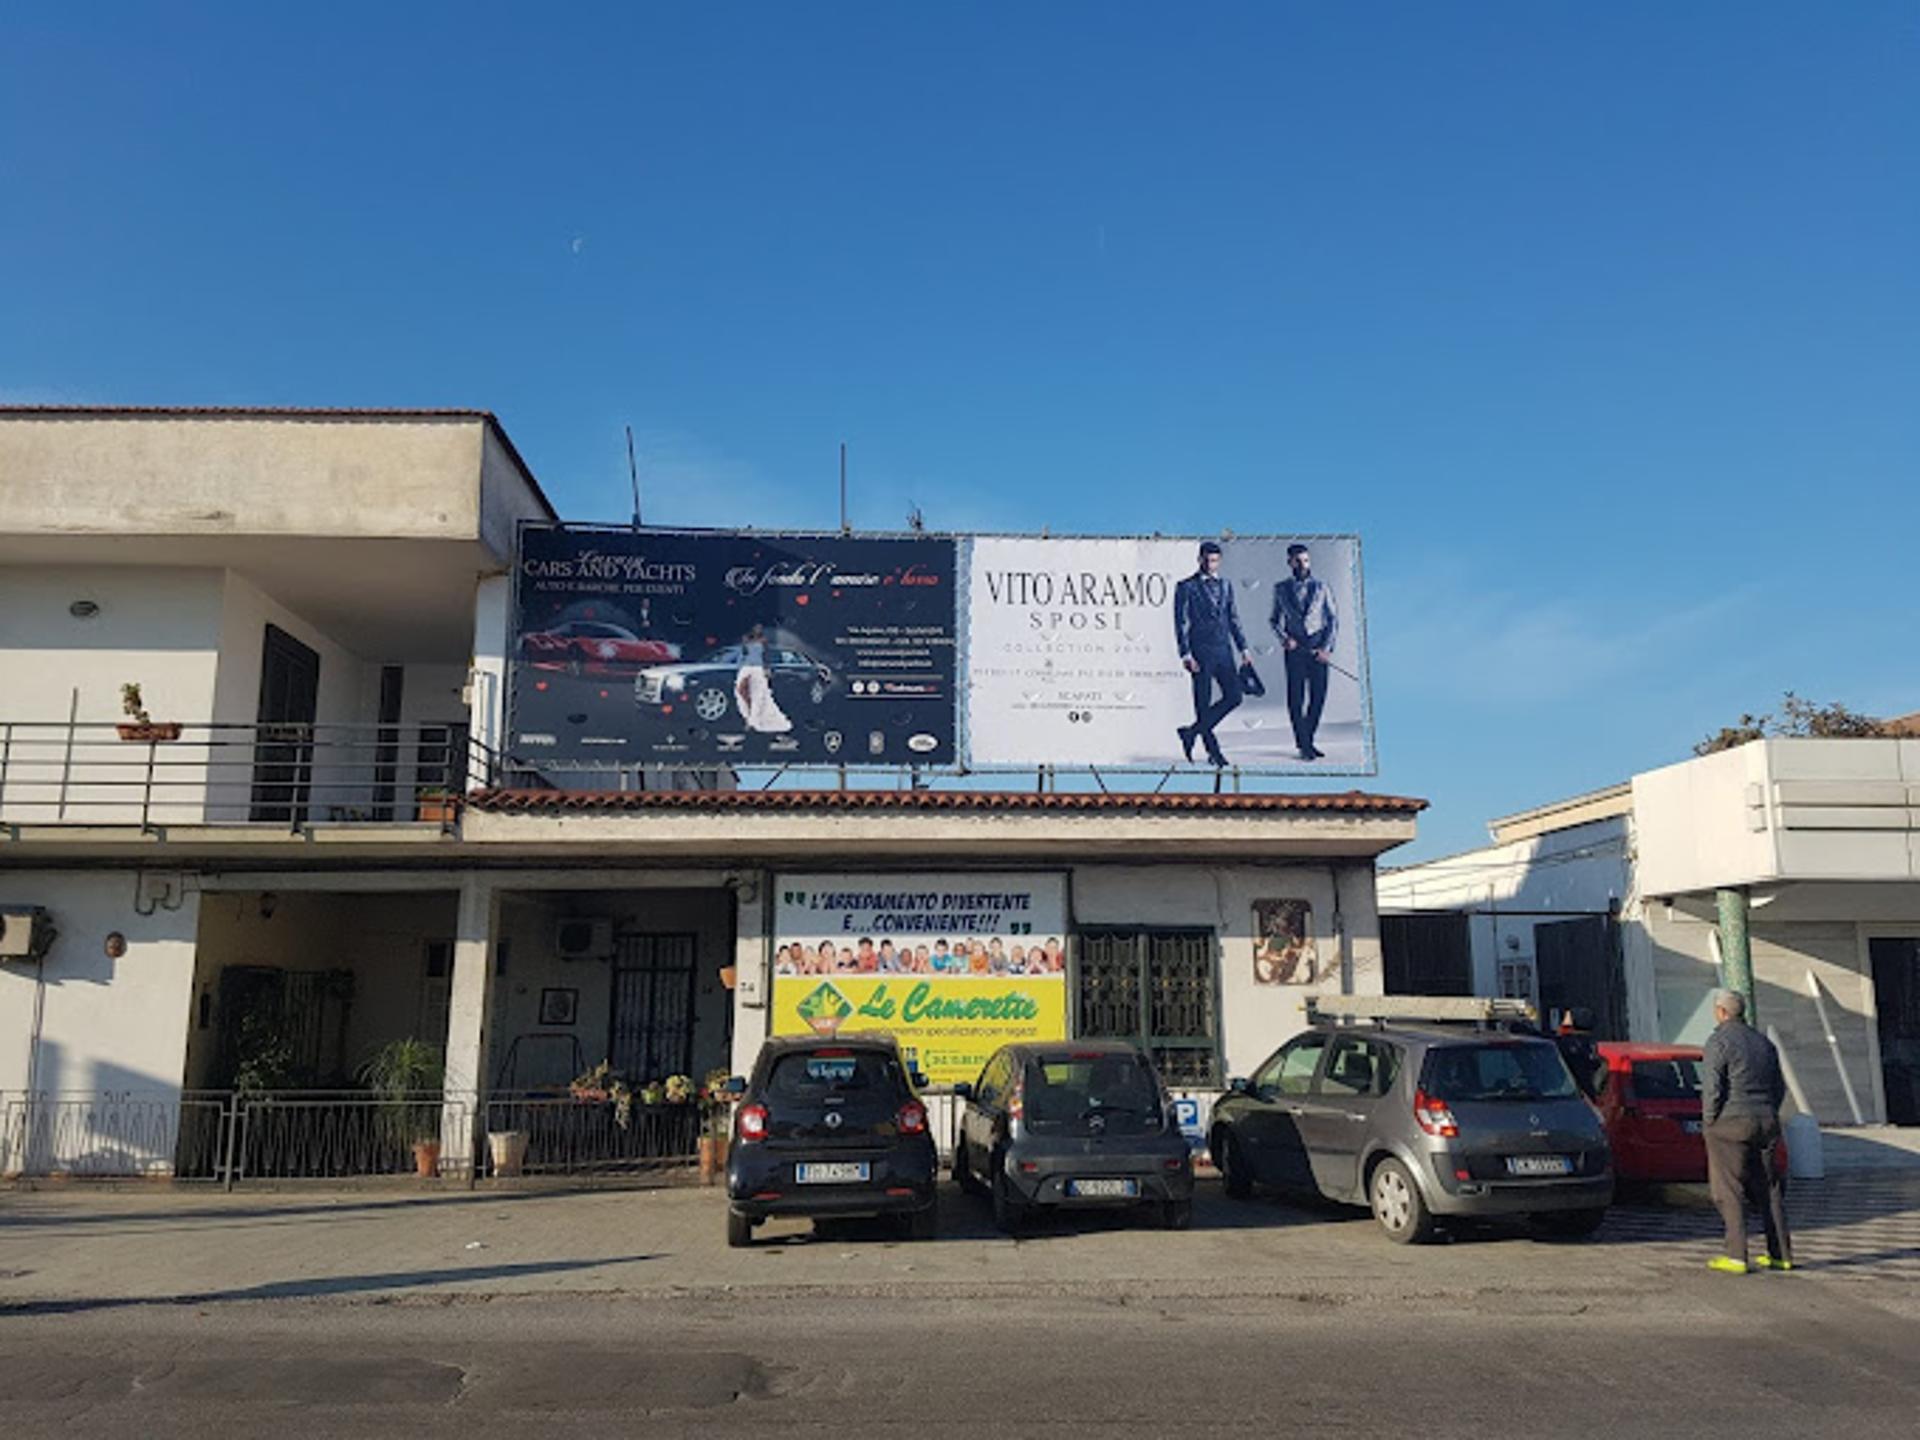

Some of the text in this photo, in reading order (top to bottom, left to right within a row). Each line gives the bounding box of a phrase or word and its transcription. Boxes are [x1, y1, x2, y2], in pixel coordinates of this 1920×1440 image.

[524, 560, 696, 581] CARS AND YACHTS
[986, 571, 1167, 607] VITO ARAMO
[1029, 612, 1122, 630] SPOSI
[1003, 643, 1105, 654] COLLECTION
[809, 891, 1031, 910] L'ARREDAMENTO DIVERTENTE
[857, 983, 896, 1019] Le
[1177, 1103, 1195, 1125] P
